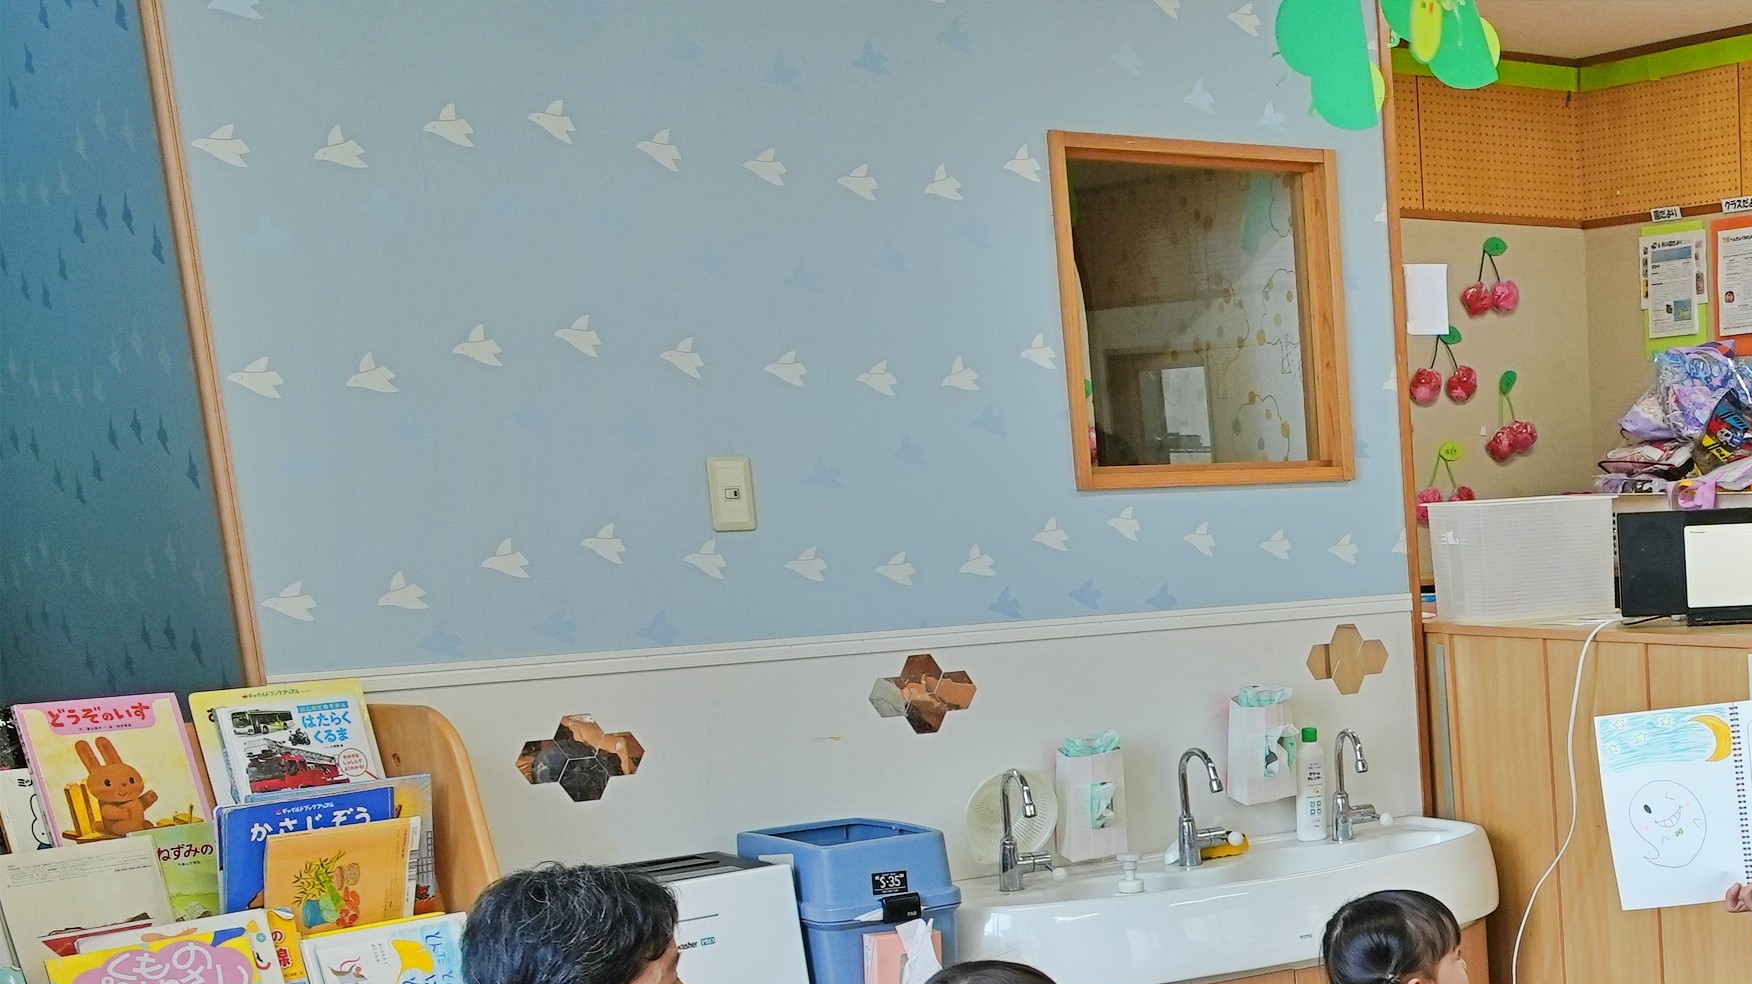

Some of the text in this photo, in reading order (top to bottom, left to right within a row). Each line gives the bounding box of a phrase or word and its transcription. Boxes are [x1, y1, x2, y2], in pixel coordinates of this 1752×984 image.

[48, 702, 150, 729] どうぞのいす
[302, 711, 352, 729] はたらく
[313, 727, 350, 744] くるま
[157, 843, 215, 862] ねずみの
[106, 942, 213, 981] くもの
